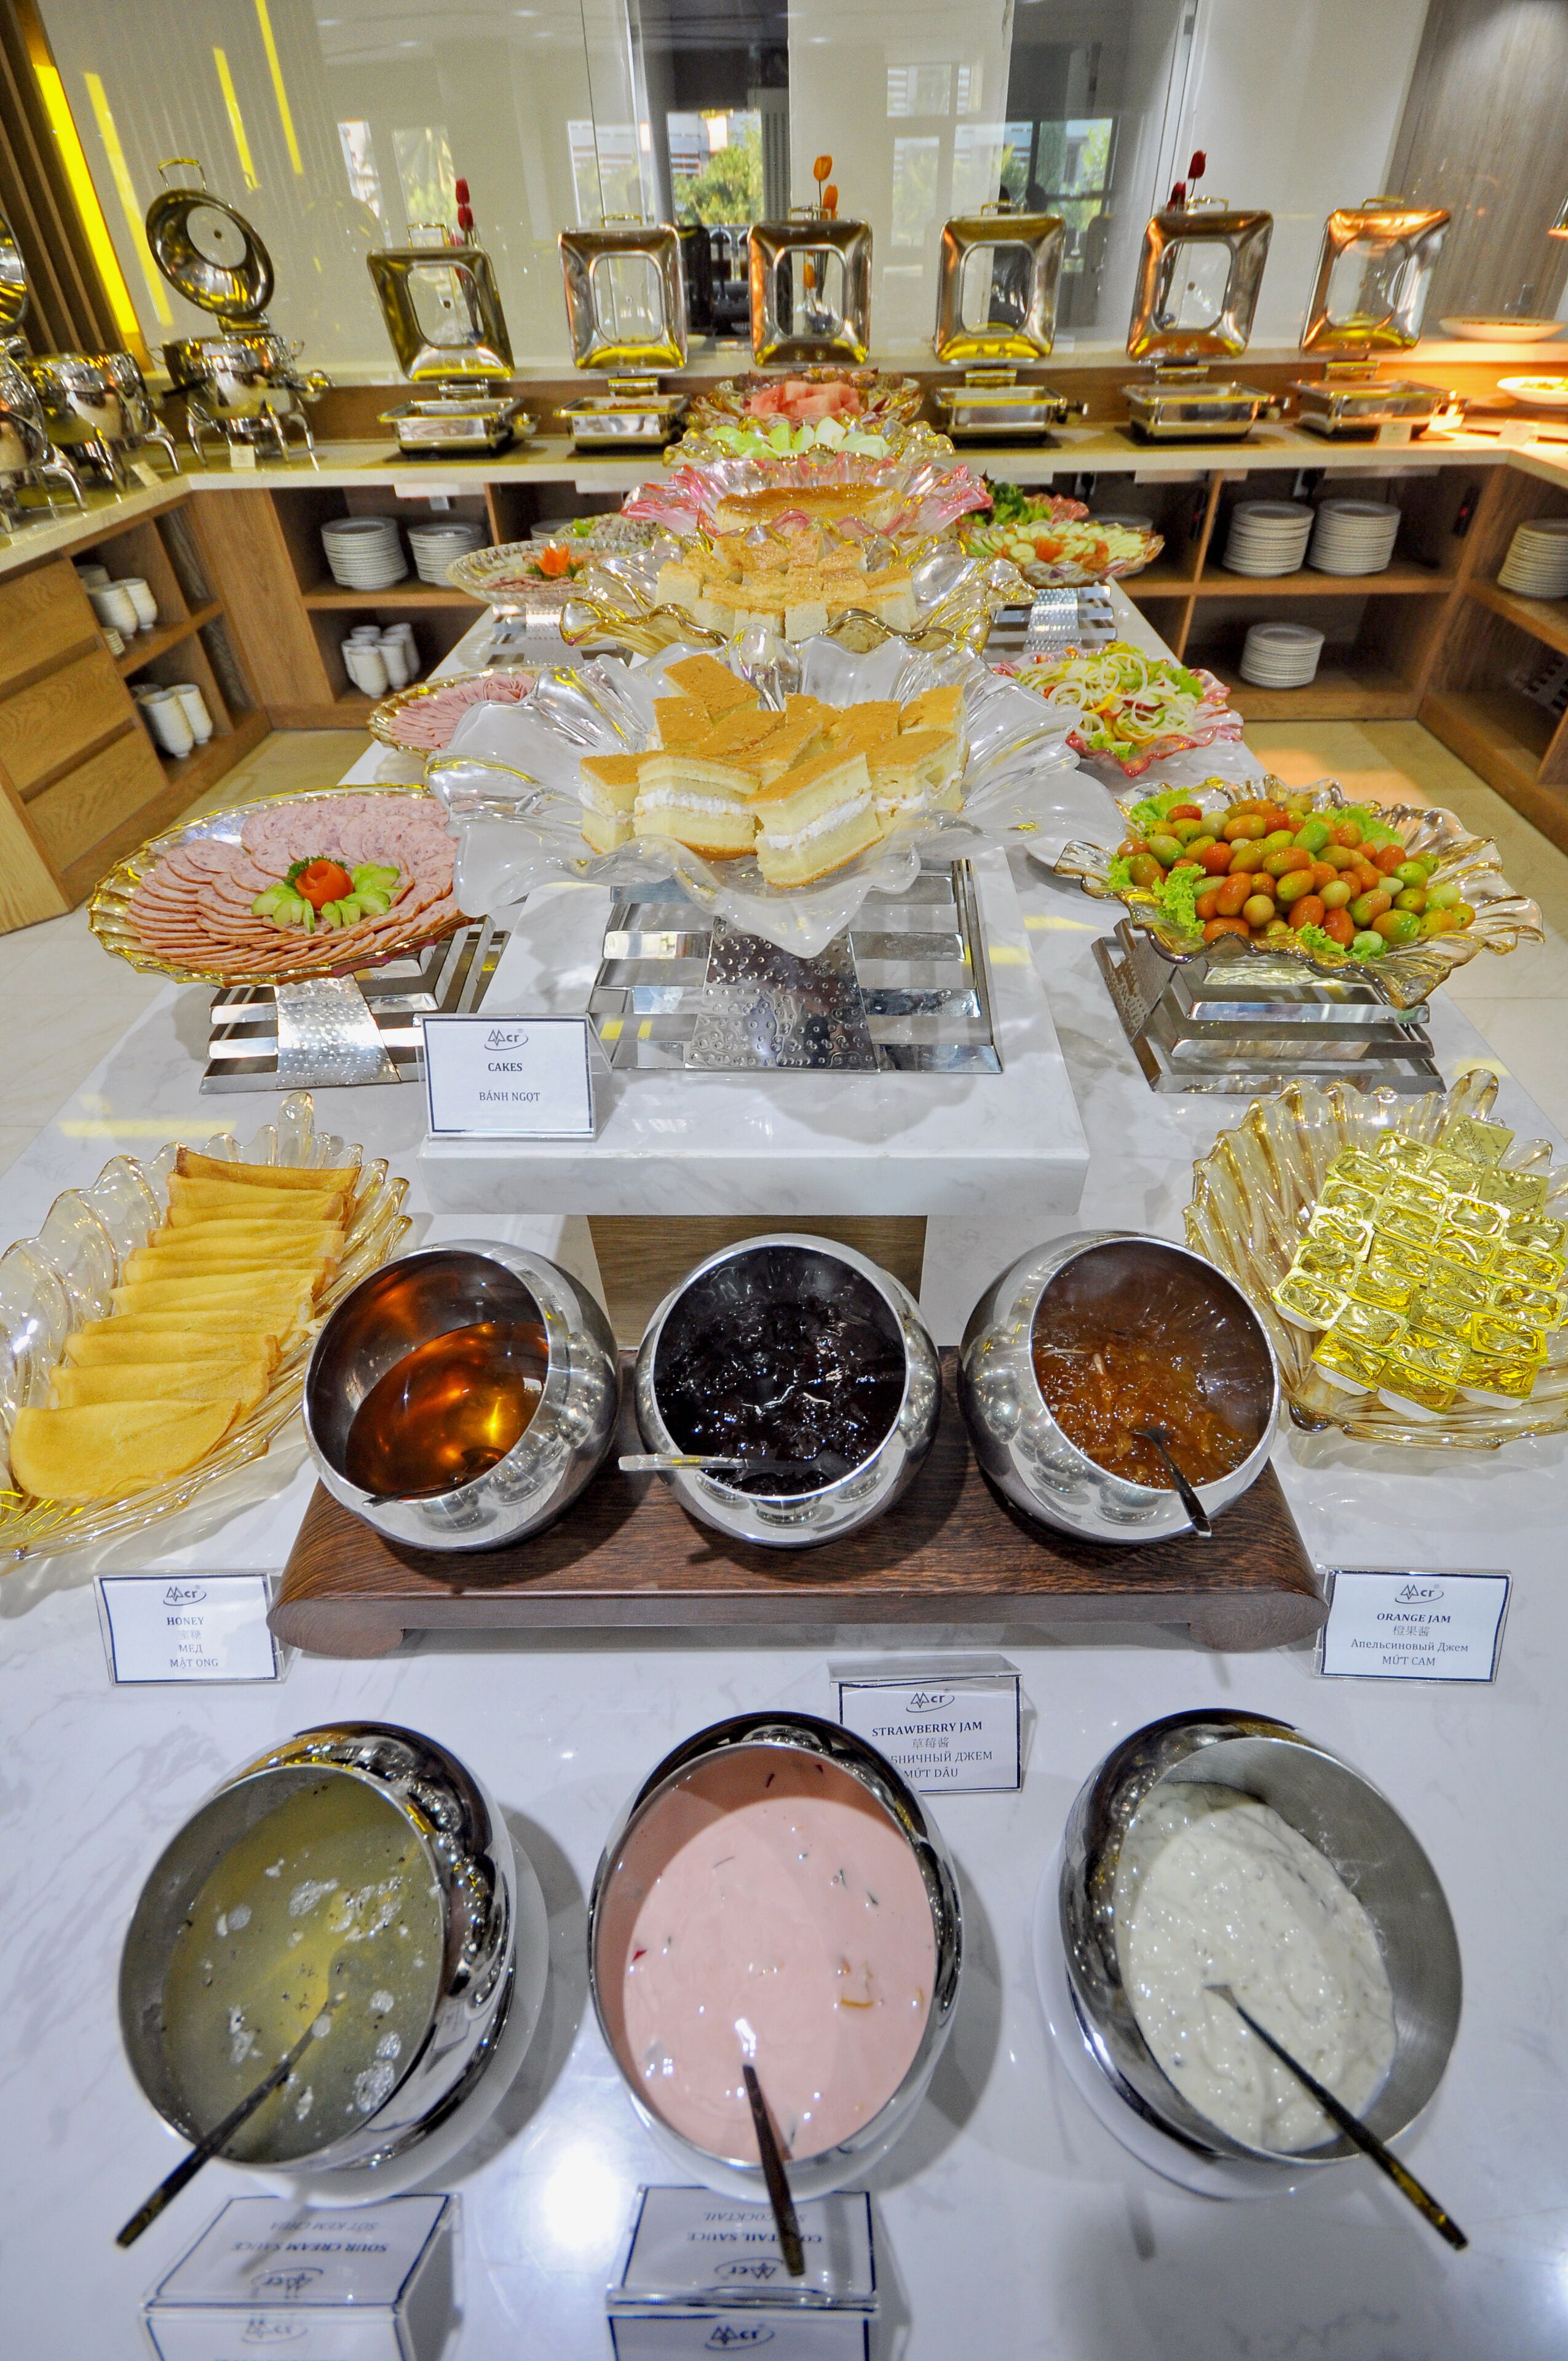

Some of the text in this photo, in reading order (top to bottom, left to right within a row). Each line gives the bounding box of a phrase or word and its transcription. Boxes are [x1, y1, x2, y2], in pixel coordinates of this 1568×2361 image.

[488, 1062, 523, 1072] CAKES
[479, 1090, 540, 1102] BÁNH NGỌT
[167, 1617, 204, 1626] HONEY
[1377, 1613, 1451, 1624] ORANGE JAM
[179, 1644, 203, 1654] МЕД
[1351, 1639, 1468, 1652] Апельсиновый Джем
[196, 1658, 218, 1667] ONG
[1411, 1656, 1435, 1666] CAM
[872, 1721, 983, 1737] STRAWBERRY JAM
[911, 1737, 949, 1750] 草莓酱
[955, 1751, 992, 1763] ДЖЕМ
[934, 1766, 958, 1778] DÂU
